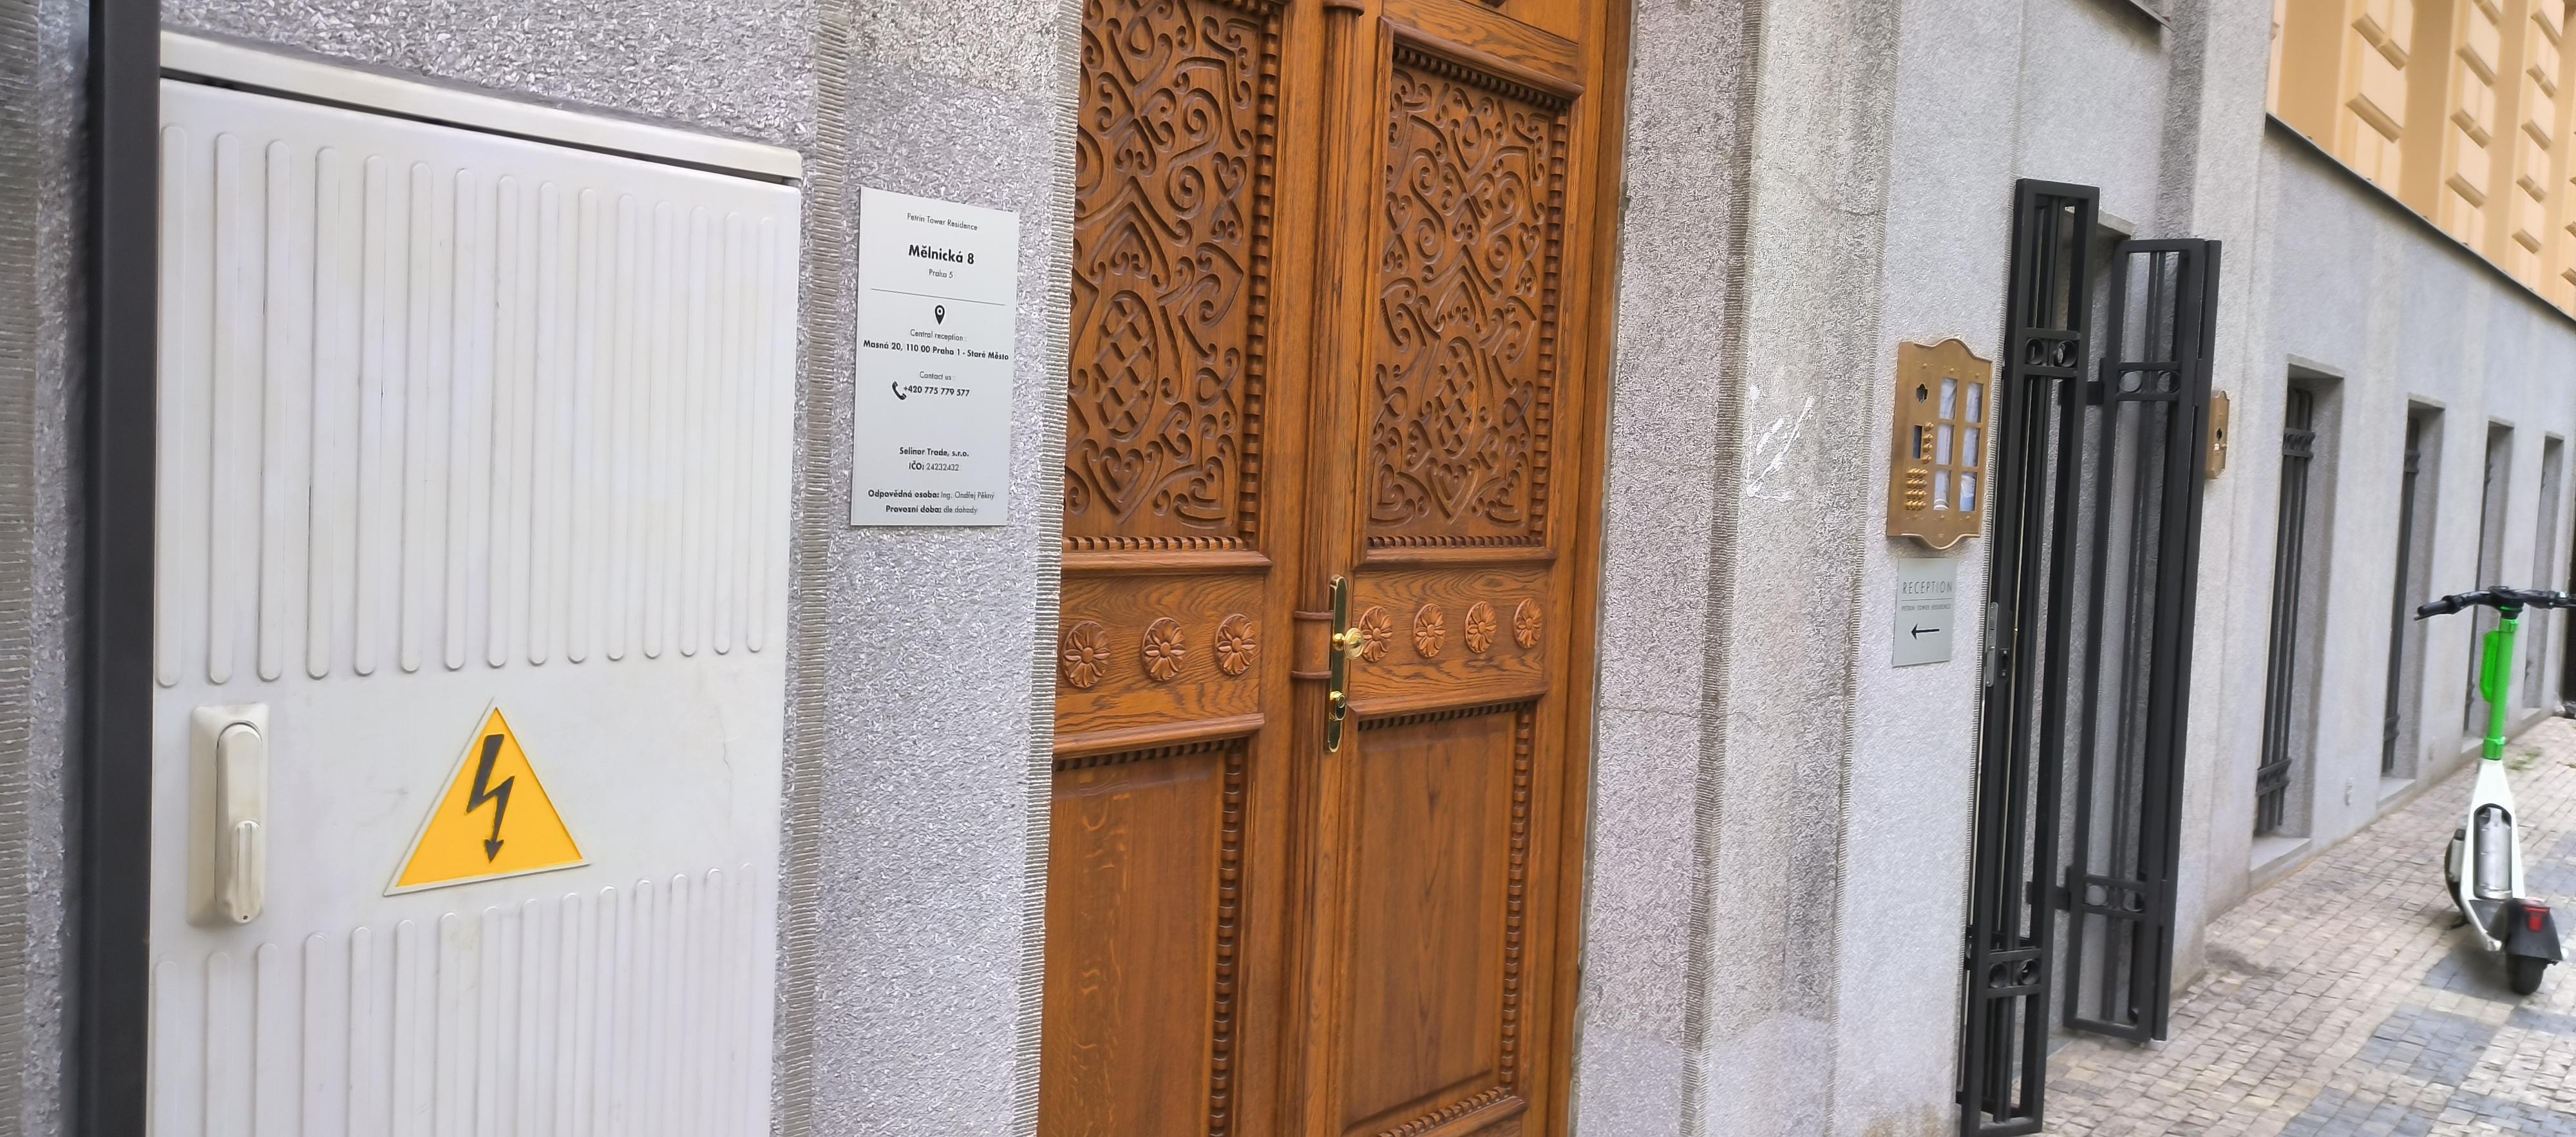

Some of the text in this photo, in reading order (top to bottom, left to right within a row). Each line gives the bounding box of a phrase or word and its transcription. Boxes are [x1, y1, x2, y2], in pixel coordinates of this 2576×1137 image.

[907, 213, 978, 231] Petrin Tower Residence
[909, 245, 974, 264] Mělnická 8
[929, 269, 947, 278] Praha
[910, 329, 933, 338] Central
[934, 332, 963, 341] reception
[864, 339, 889, 349] Masná
[891, 343, 903, 351] 20,
[906, 343, 918, 352] 110
[920, 345, 931, 353] 00
[933, 346, 954, 356] Praha
[967, 350, 985, 358] Staré
[988, 351, 1009, 360] Město
[919, 371, 943, 380] Contact
[927, 448, 949, 457] Trade,
[868, 490, 912, 499] Odpovědná
[941, 492, 952, 500] Ing.
[954, 491, 976, 500] Ondřej
[954, 506, 977, 515] dohody
[1902, 581, 1953, 593] RECEPTION
